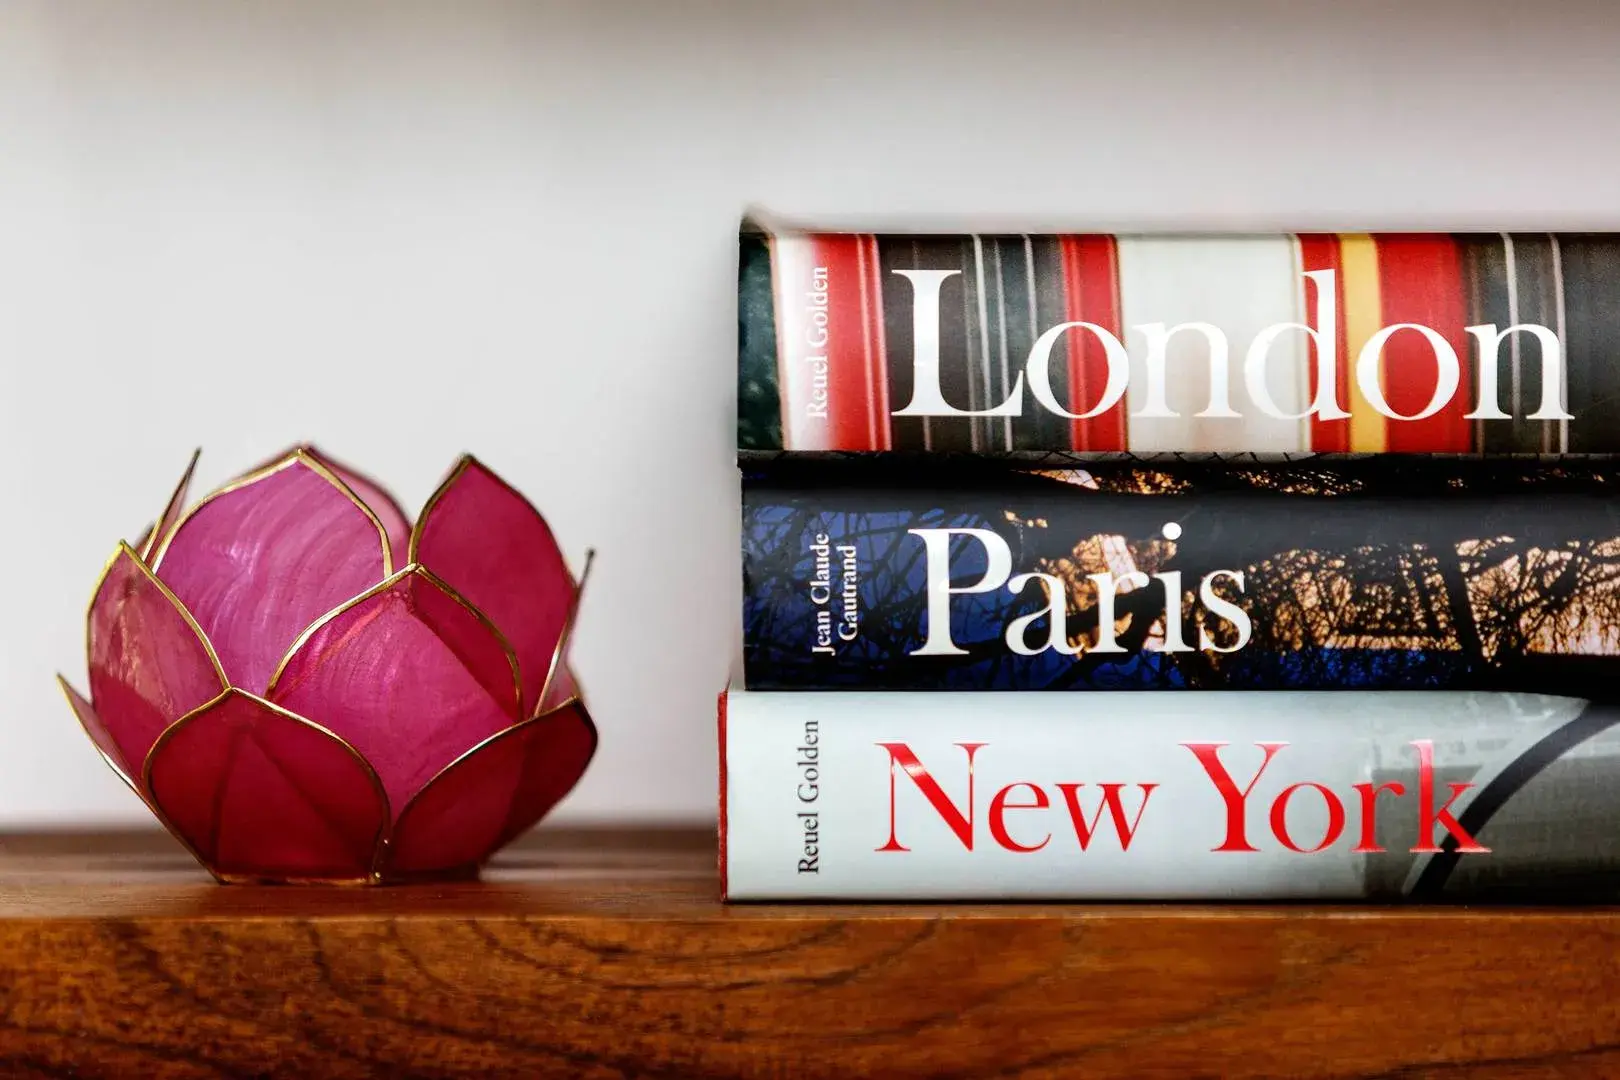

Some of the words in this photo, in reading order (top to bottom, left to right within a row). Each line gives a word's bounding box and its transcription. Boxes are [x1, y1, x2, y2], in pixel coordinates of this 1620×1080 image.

[805, 266, 828, 348] Golden
[891, 268, 1576, 422] London
[805, 356, 828, 419] Reuel
[809, 533, 831, 605] Claude
[836, 545, 858, 641] Gautrand
[907, 521, 1253, 656] Paris
[811, 611, 836, 656] Jean
[797, 720, 819, 803] Golden
[873, 742, 1161, 853] New
[1177, 739, 1494, 853] York
[797, 812, 819, 875] Reuel
